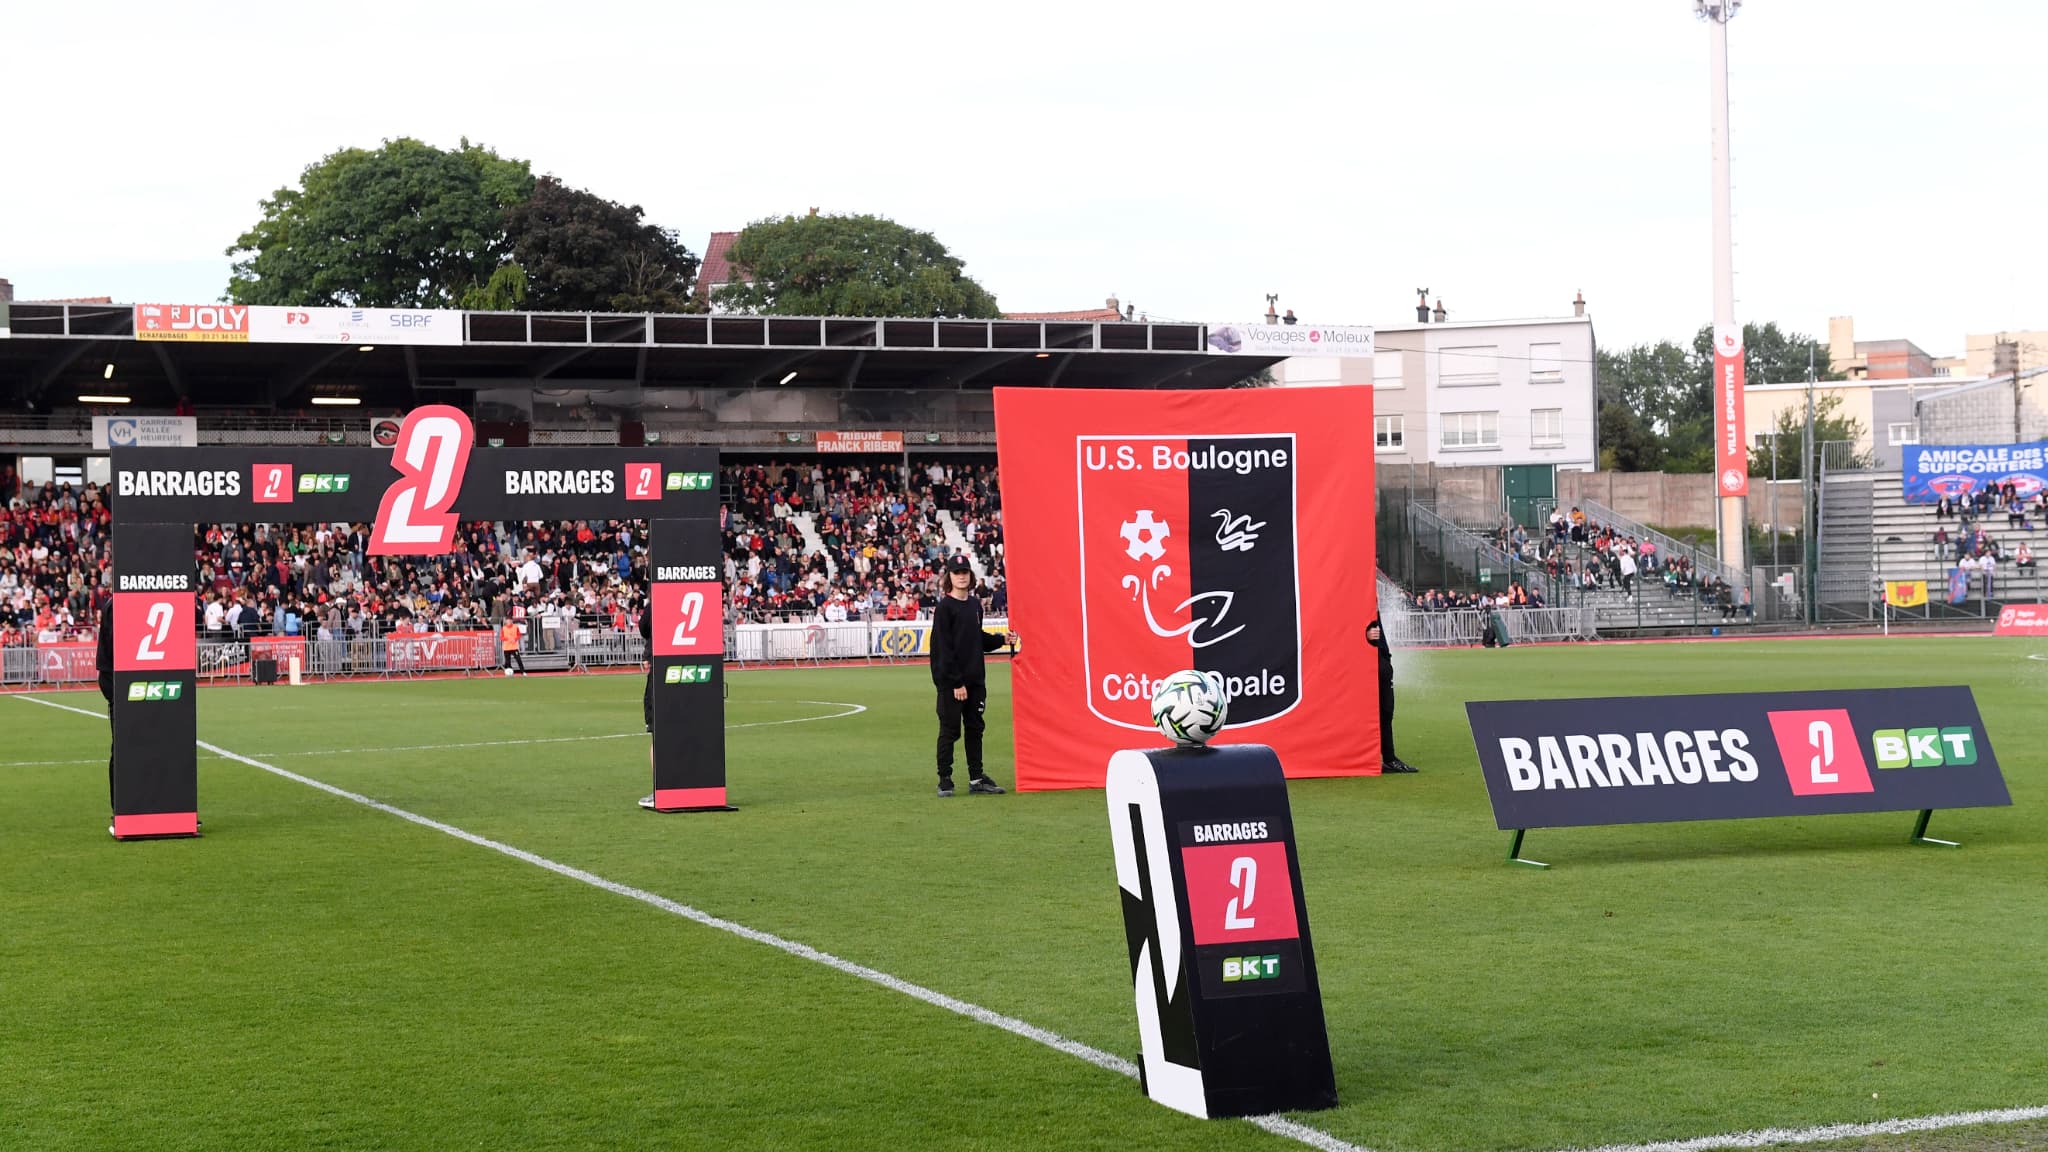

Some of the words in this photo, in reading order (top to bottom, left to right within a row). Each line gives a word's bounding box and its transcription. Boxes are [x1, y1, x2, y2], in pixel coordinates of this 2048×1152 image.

[171, 308, 246, 330] JOLY
[1248, 328, 1306, 343] Voyages
[1323, 330, 1370, 343] Moleux
[1725, 364, 1736, 421] SPORTIVE
[114, 428, 131, 437] VH
[836, 432, 883, 441] TRIBUNE
[1727, 423, 1737, 456] VILLE
[817, 441, 861, 452] FRANCK
[863, 441, 901, 452] RIBERY
[1918, 448, 2008, 463] AMICALE
[2012, 448, 2042, 460] DES
[1086, 446, 1142, 470] U.S.
[1152, 445, 1287, 475] Boulogne
[1918, 458, 2044, 473] SUPPORTERS
[118, 470, 241, 496] BARRAGES
[263, 468, 283, 498] 2
[299, 475, 349, 491] BKT
[505, 470, 614, 494] BARRAGES
[635, 467, 652, 496] 2
[667, 474, 712, 489] BKT
[119, 574, 188, 590] BARRAGES
[657, 566, 717, 581] BARRAGES
[671, 591, 704, 646] 2
[135, 602, 174, 661] 2
[391, 641, 437, 661] SEV
[667, 668, 711, 682] BKT
[128, 683, 180, 699] BKT
[1499, 728, 1759, 791] BARRAGES
[1809, 720, 1839, 784] 2
[1876, 732, 1971, 762] BKT
[1193, 821, 1268, 843] BARRAGES
[1224, 856, 1257, 930] 2
[1223, 957, 1279, 980] BKT
